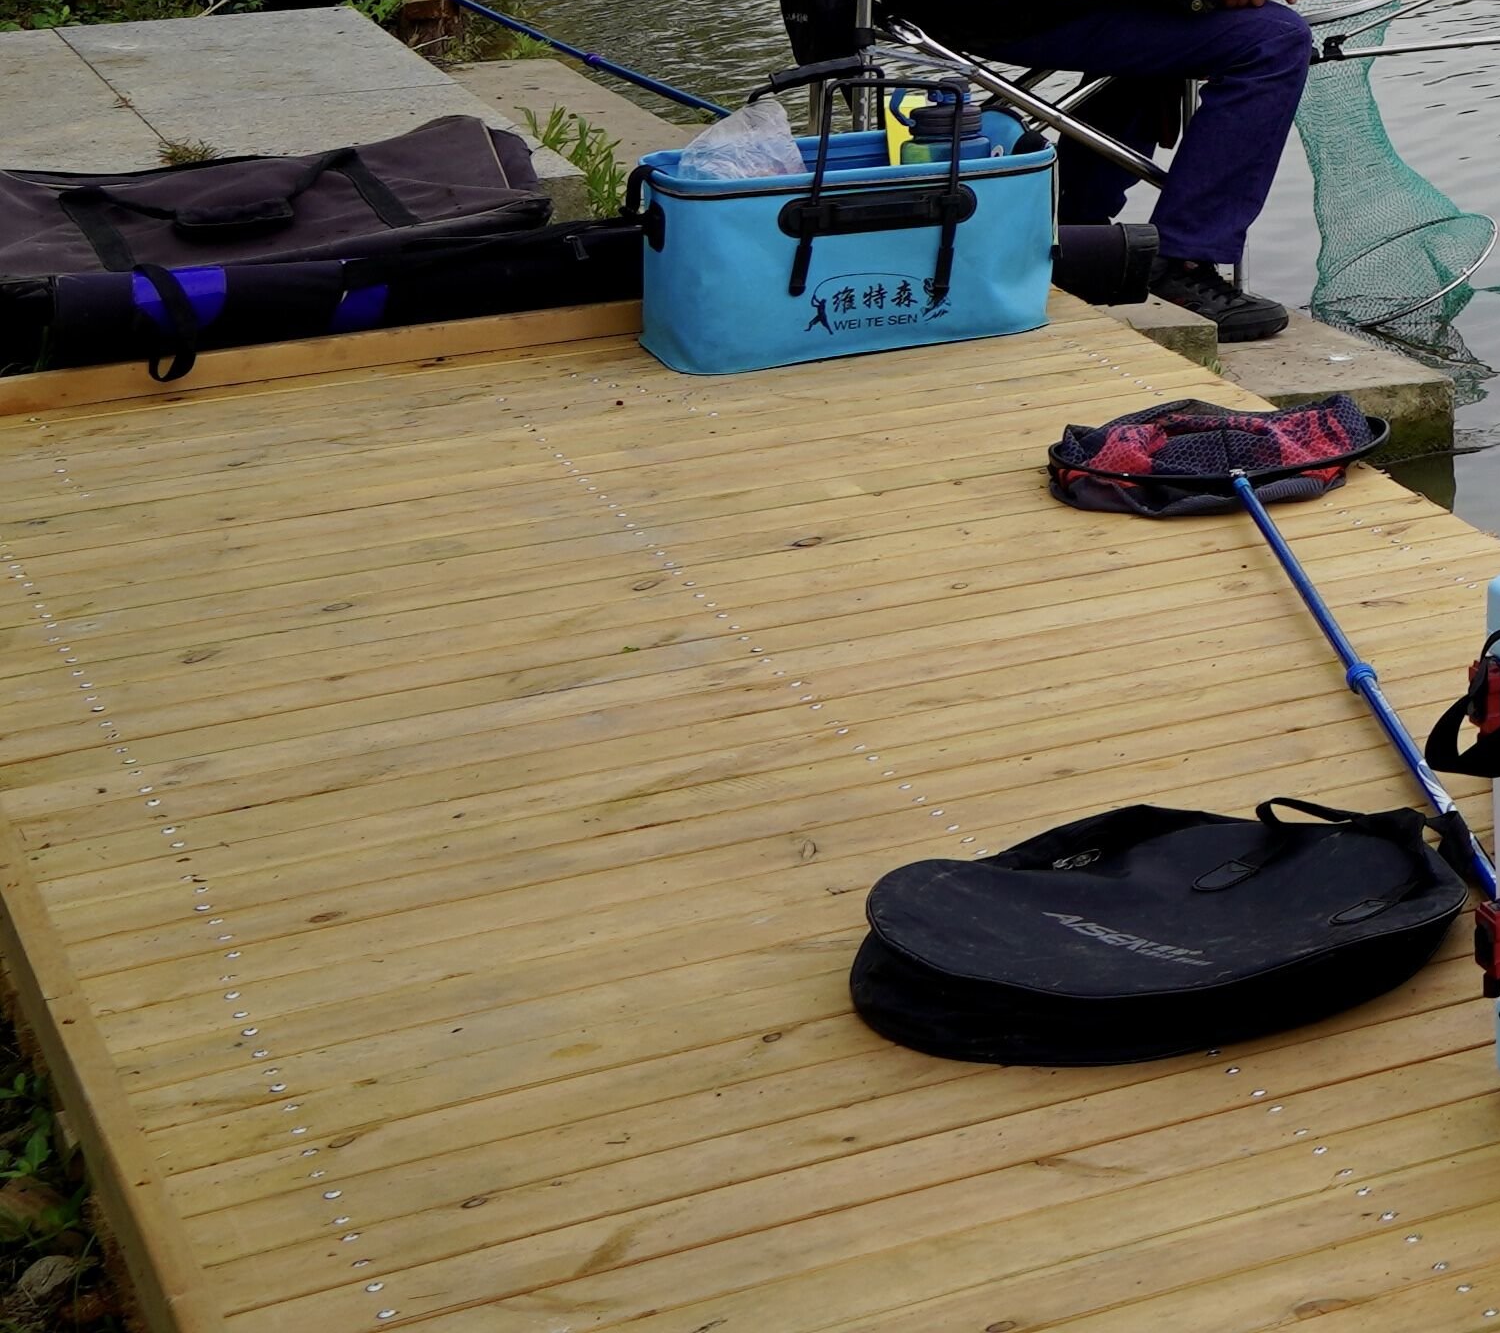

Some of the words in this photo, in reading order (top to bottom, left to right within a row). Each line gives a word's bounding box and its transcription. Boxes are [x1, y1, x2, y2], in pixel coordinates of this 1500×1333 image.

[832, 279, 919, 314] 维特森
[833, 317, 861, 331] WEI
[866, 316, 884, 327] TE
[887, 314, 918, 326] SEN
